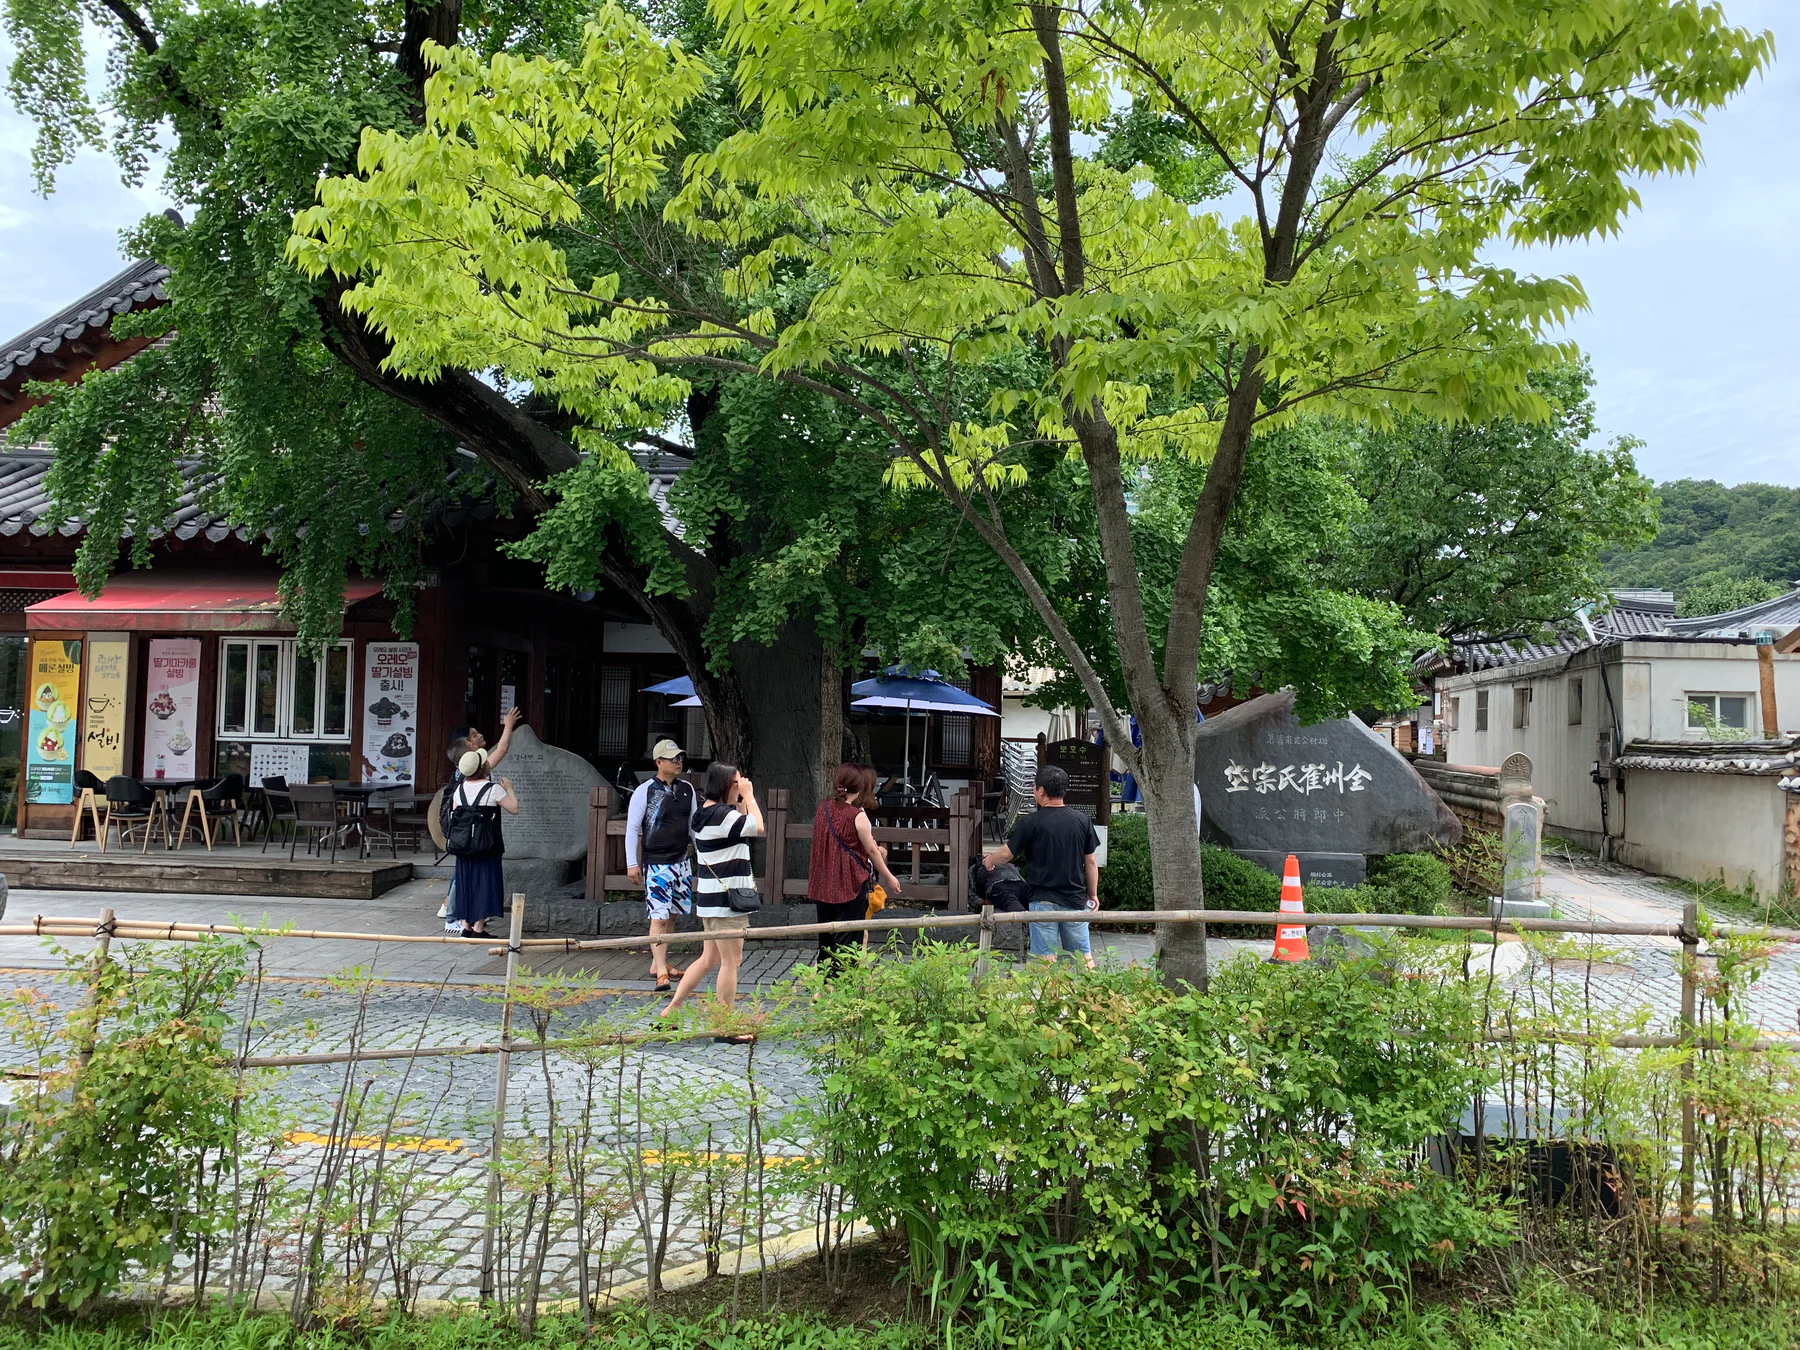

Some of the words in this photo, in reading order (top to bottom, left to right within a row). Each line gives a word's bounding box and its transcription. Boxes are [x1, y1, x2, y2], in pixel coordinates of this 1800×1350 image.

[153, 657, 197, 669] 딸기마카롱
[377, 653, 408, 665] 오레오
[166, 668, 184, 679] 설빙
[371, 667, 413, 679] 딸기설빙
[380, 679, 404, 691] 출시!
[87, 727, 120, 750] 설빙
